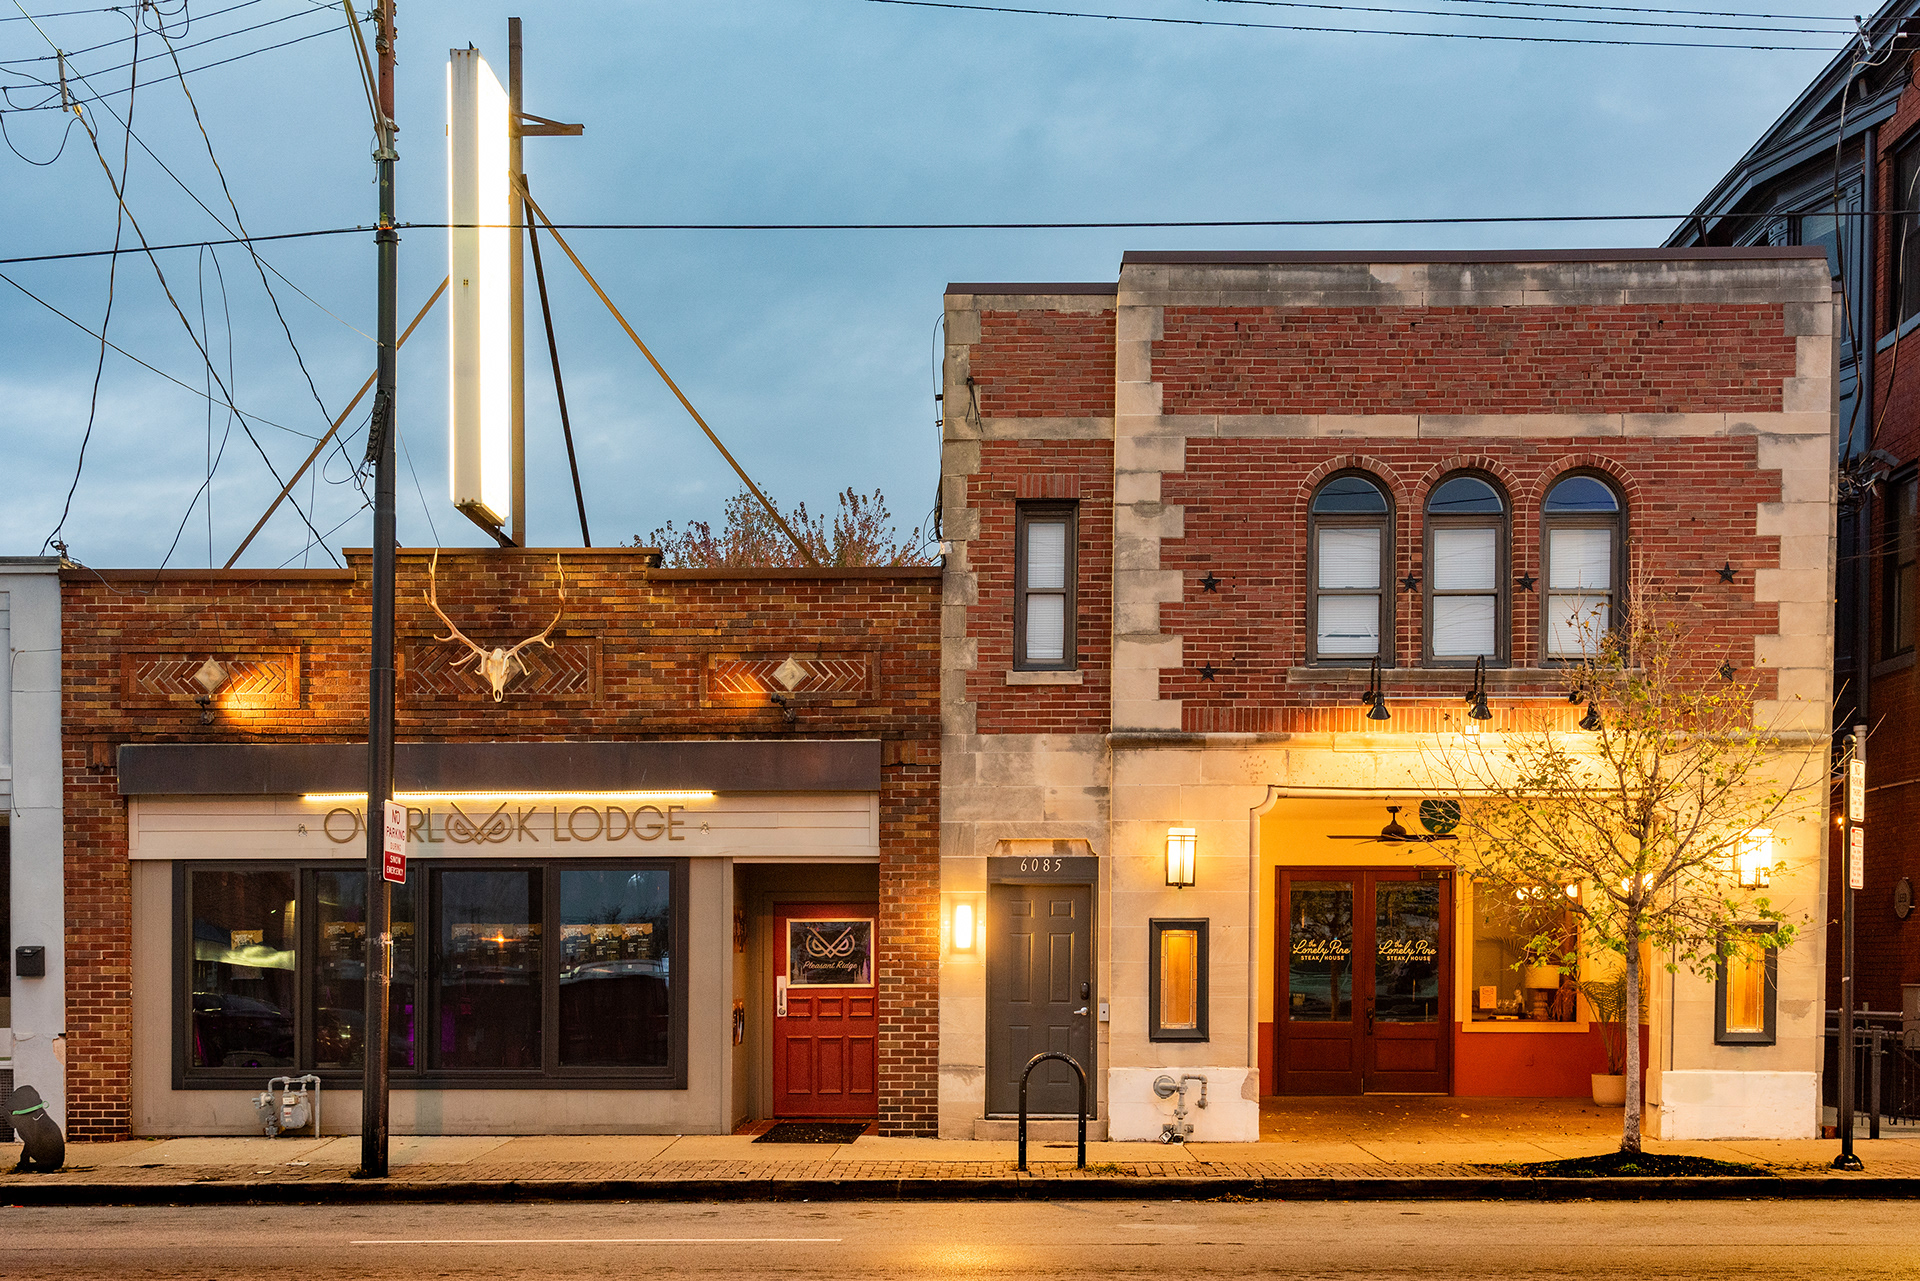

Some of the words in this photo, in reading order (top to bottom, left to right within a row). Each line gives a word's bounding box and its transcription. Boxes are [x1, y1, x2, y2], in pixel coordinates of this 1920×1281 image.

[324, 802, 539, 844] OVRLOOK
[553, 805, 685, 842] LODGE
[392, 809, 401, 825] NO
[386, 825, 406, 841] PARKING
[390, 842, 401, 852] DURING
[390, 855, 402, 865] SNOW
[1020, 858, 1062, 872] 6085
[386, 865, 404, 877] EMERGENCY
[1308, 939, 1317, 947] the
[1293, 939, 1329, 963] Lonely
[1329, 939, 1351, 954] Pine
[1379, 939, 1415, 963] Lonely
[1415, 939, 1437, 955] Pine
[803, 960, 835, 969] Pleasant
[836, 960, 858, 972] Ridge
